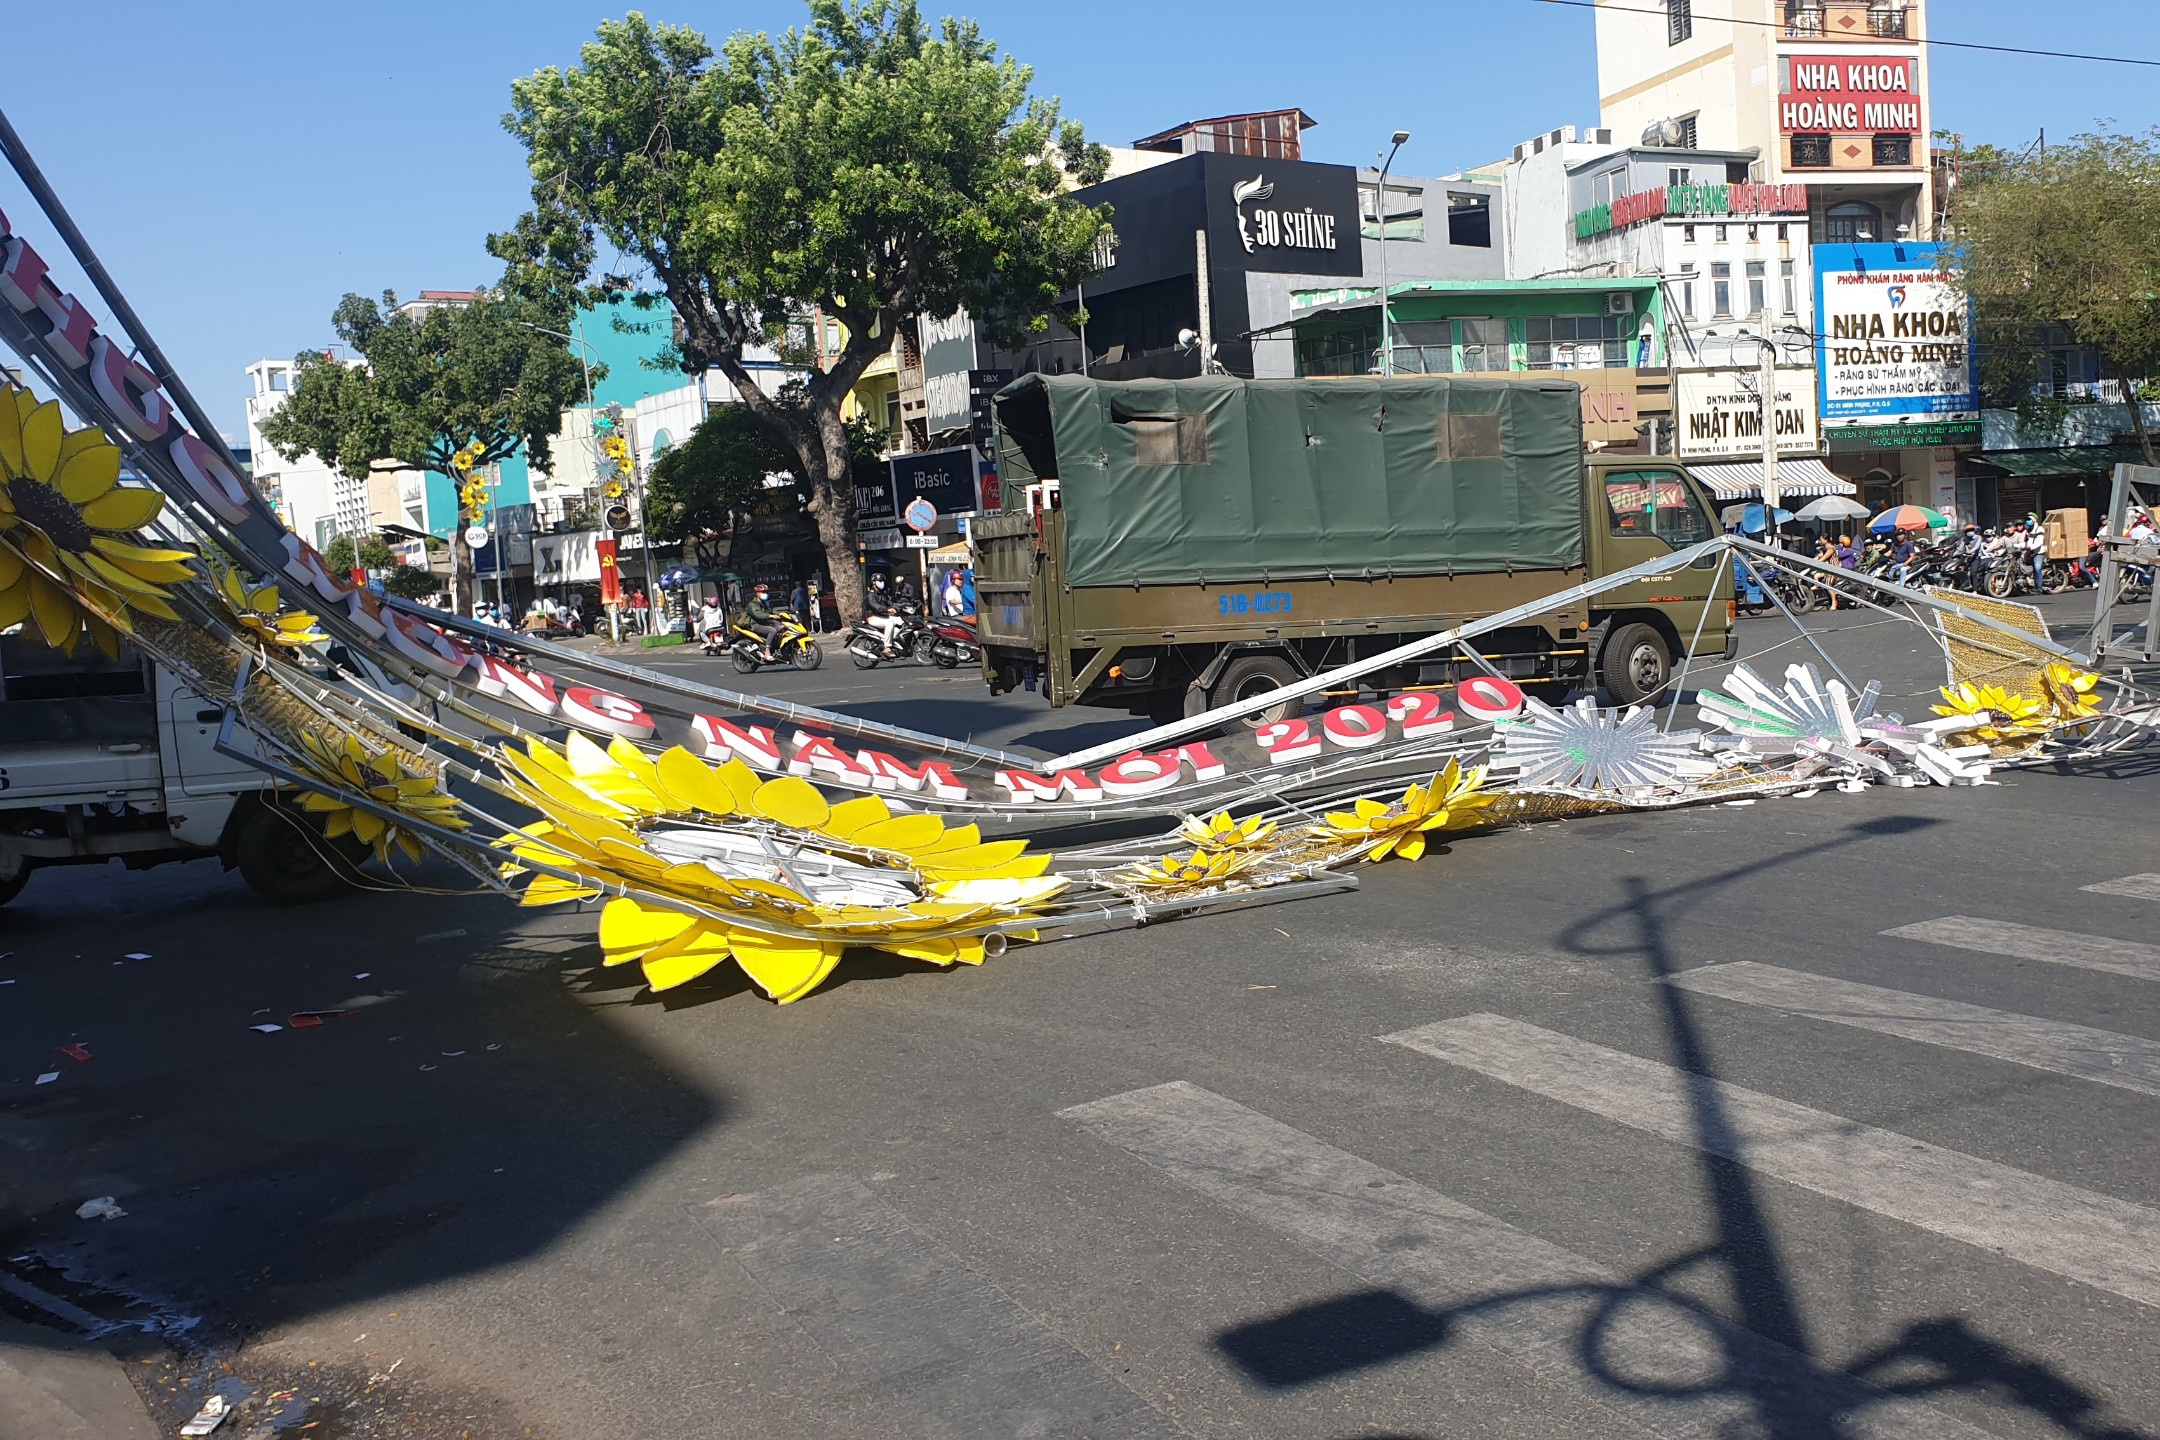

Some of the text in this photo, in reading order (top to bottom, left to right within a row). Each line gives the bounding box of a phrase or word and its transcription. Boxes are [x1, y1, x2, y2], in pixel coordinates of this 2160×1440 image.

[1796, 64, 1907, 92] NHA KHOA
[1782, 96, 1918, 130] HOÀNG MINH
[1254, 208, 1336, 250] 30 SHINE
[1837, 273, 1865, 285] PHÒNG
[1867, 272, 1890, 284] KHÁM
[1892, 272, 1914, 284] RĂNG
[1833, 311, 1961, 340] NHA KHOA
[1833, 339, 1963, 366] HOÀNG MINH
[1882, 365, 1907, 380] THẨM
[1707, 395, 1727, 405] DNTN
[1729, 394, 1746, 404] KINH
[1866, 383, 1887, 395] HÌNH
[1918, 381, 1936, 393] CÁC
[1690, 406, 1730, 444] NHẬT
[1775, 409, 1805, 436] OAN
[871, 485, 885, 498] 206
[914, 468, 951, 490] iBasic
[1219, 592, 1293, 616] 51B-0273
[1255, 676, 1523, 765] 2020
